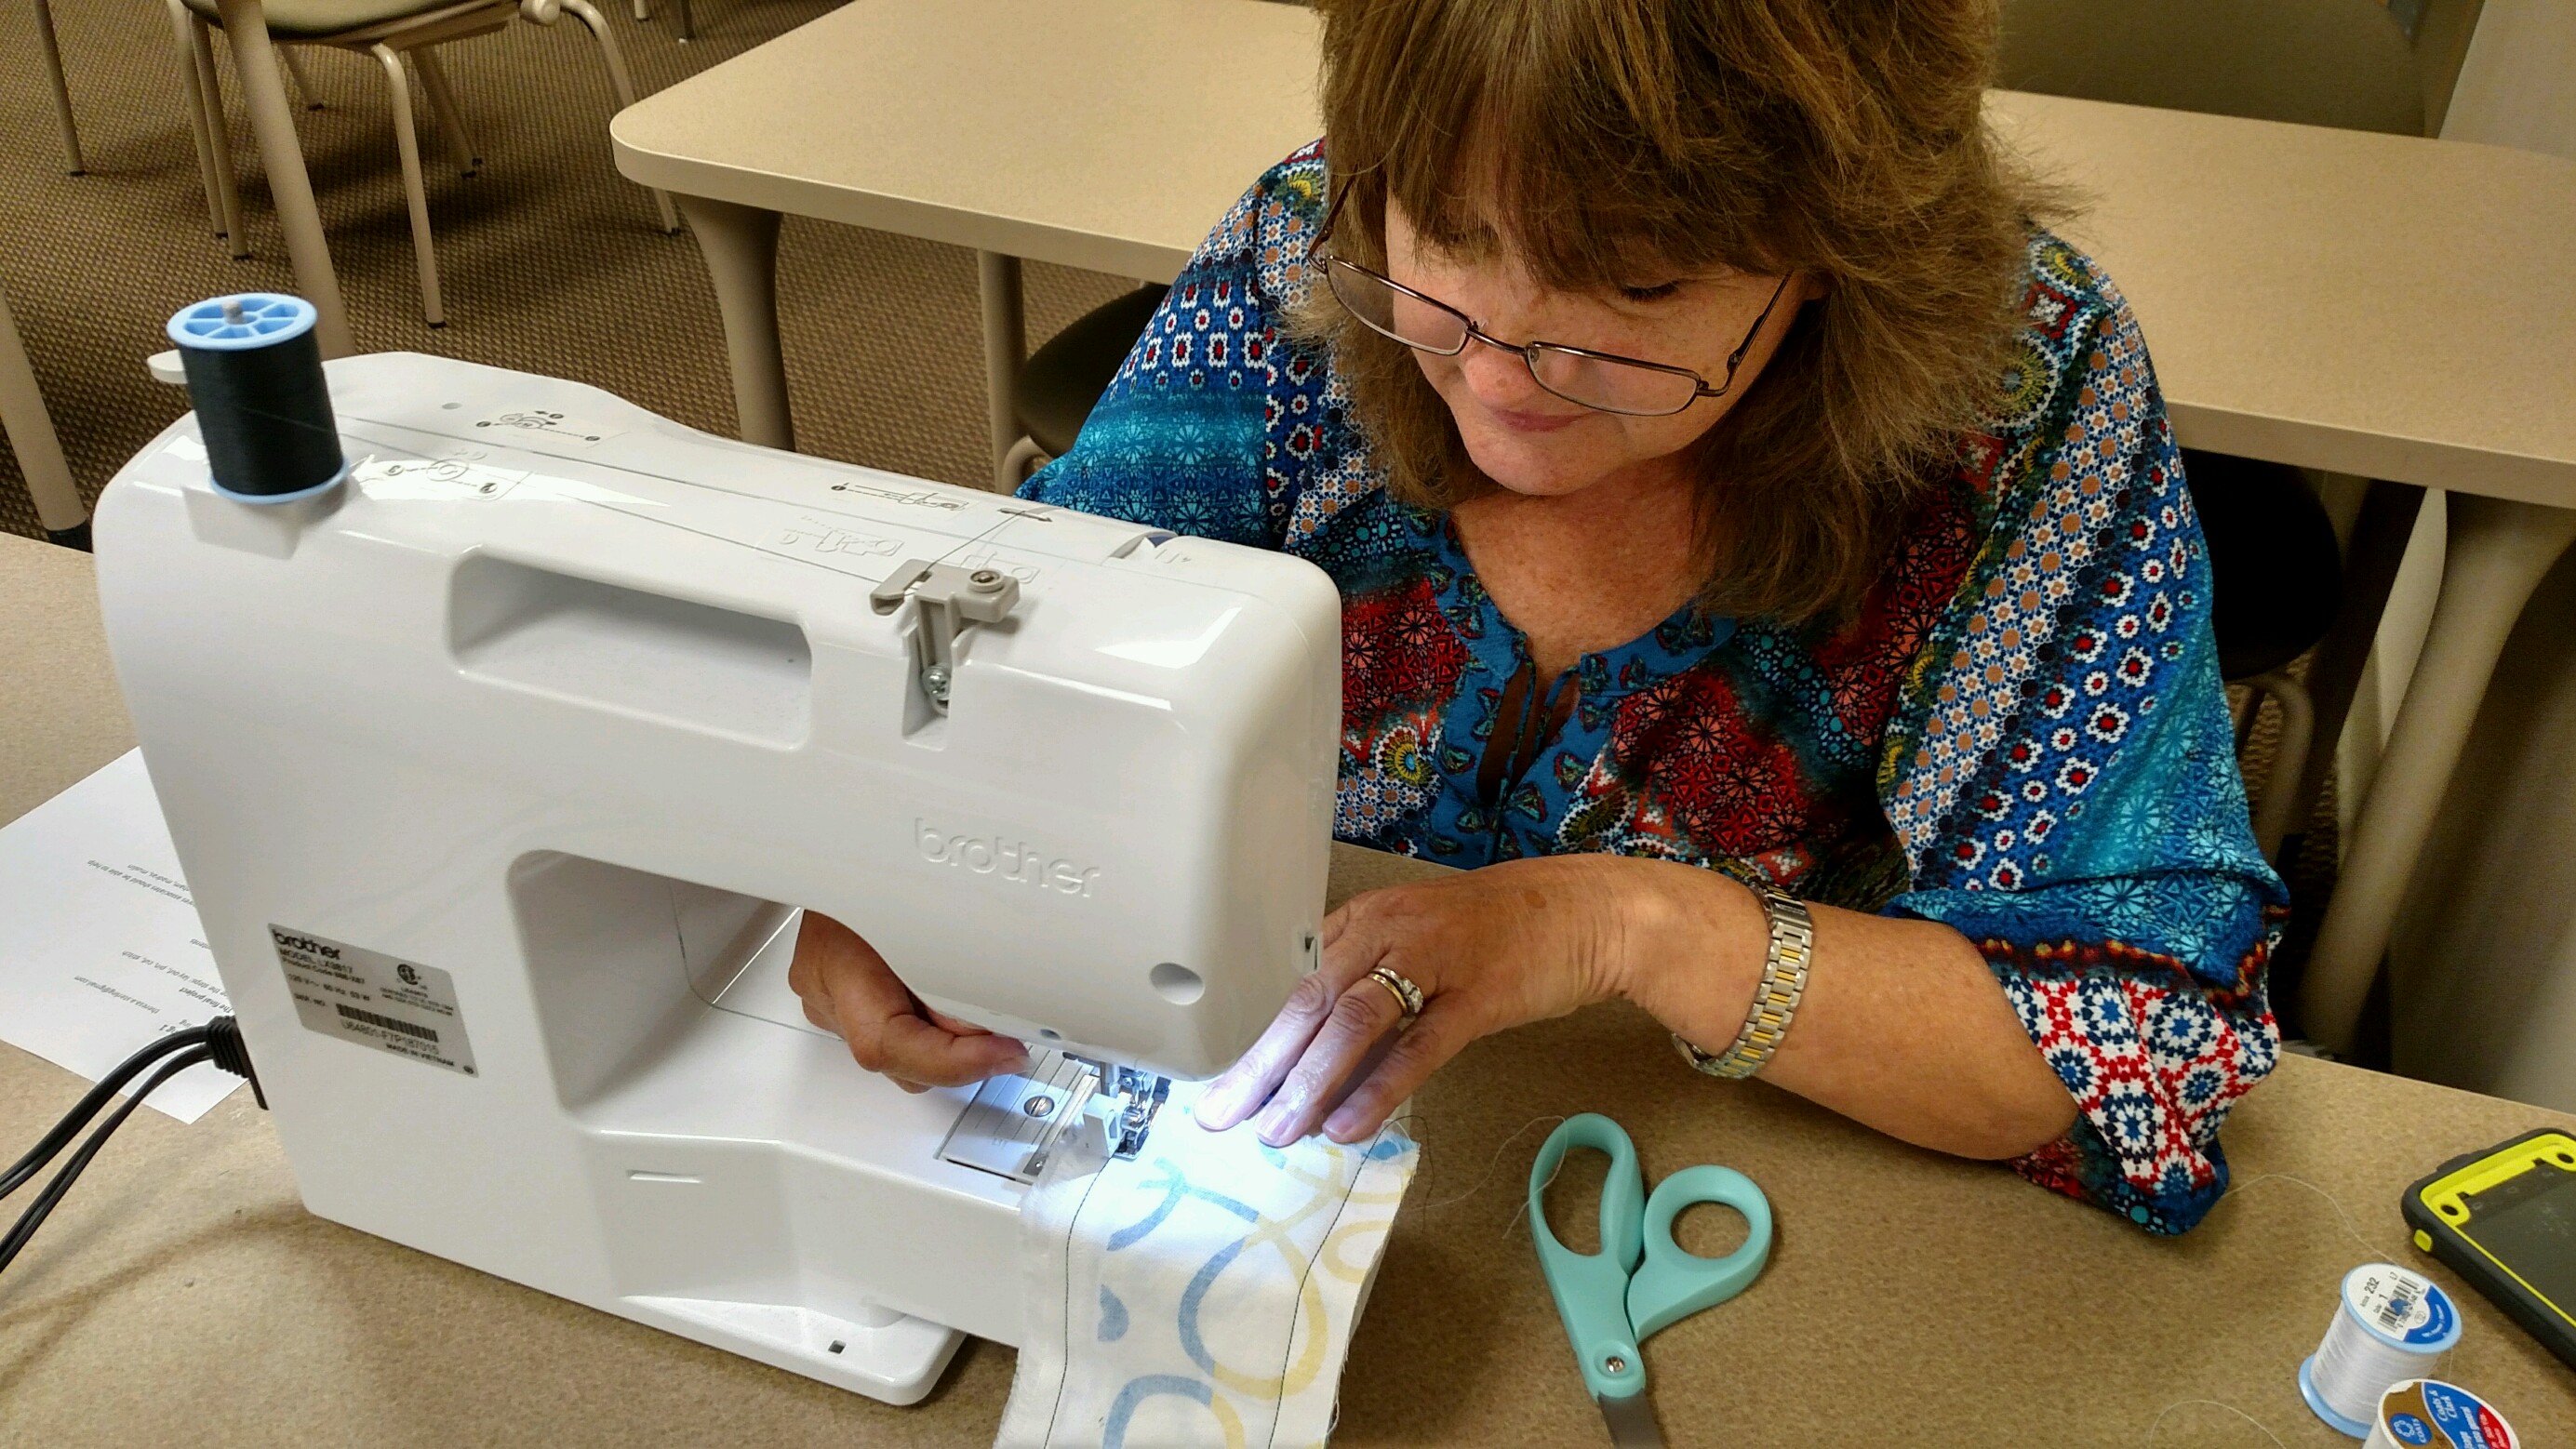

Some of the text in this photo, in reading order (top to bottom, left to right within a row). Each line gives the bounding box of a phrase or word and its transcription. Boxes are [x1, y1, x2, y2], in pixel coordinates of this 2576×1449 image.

[87, 859, 102, 870] help
[914, 817, 1101, 897] brother
[127, 864, 148, 874] muslin
[129, 877, 151, 888] should
[151, 884, 181, 900] associates
[271, 929, 340, 960] brother
[122, 950, 140, 961] stitch
[279, 948, 316, 964] MODEL
[208, 985, 221, 994] the
[179, 987, 233, 1014] The final project
[386, 1043, 454, 1067] MADE IN VIETNAM
[2364, 1276, 2380, 1294] 232
[2428, 1389, 2449, 1422] Coats &
[2441, 1395, 2459, 1418] Clark
[2411, 1417, 2426, 1443] COATS
